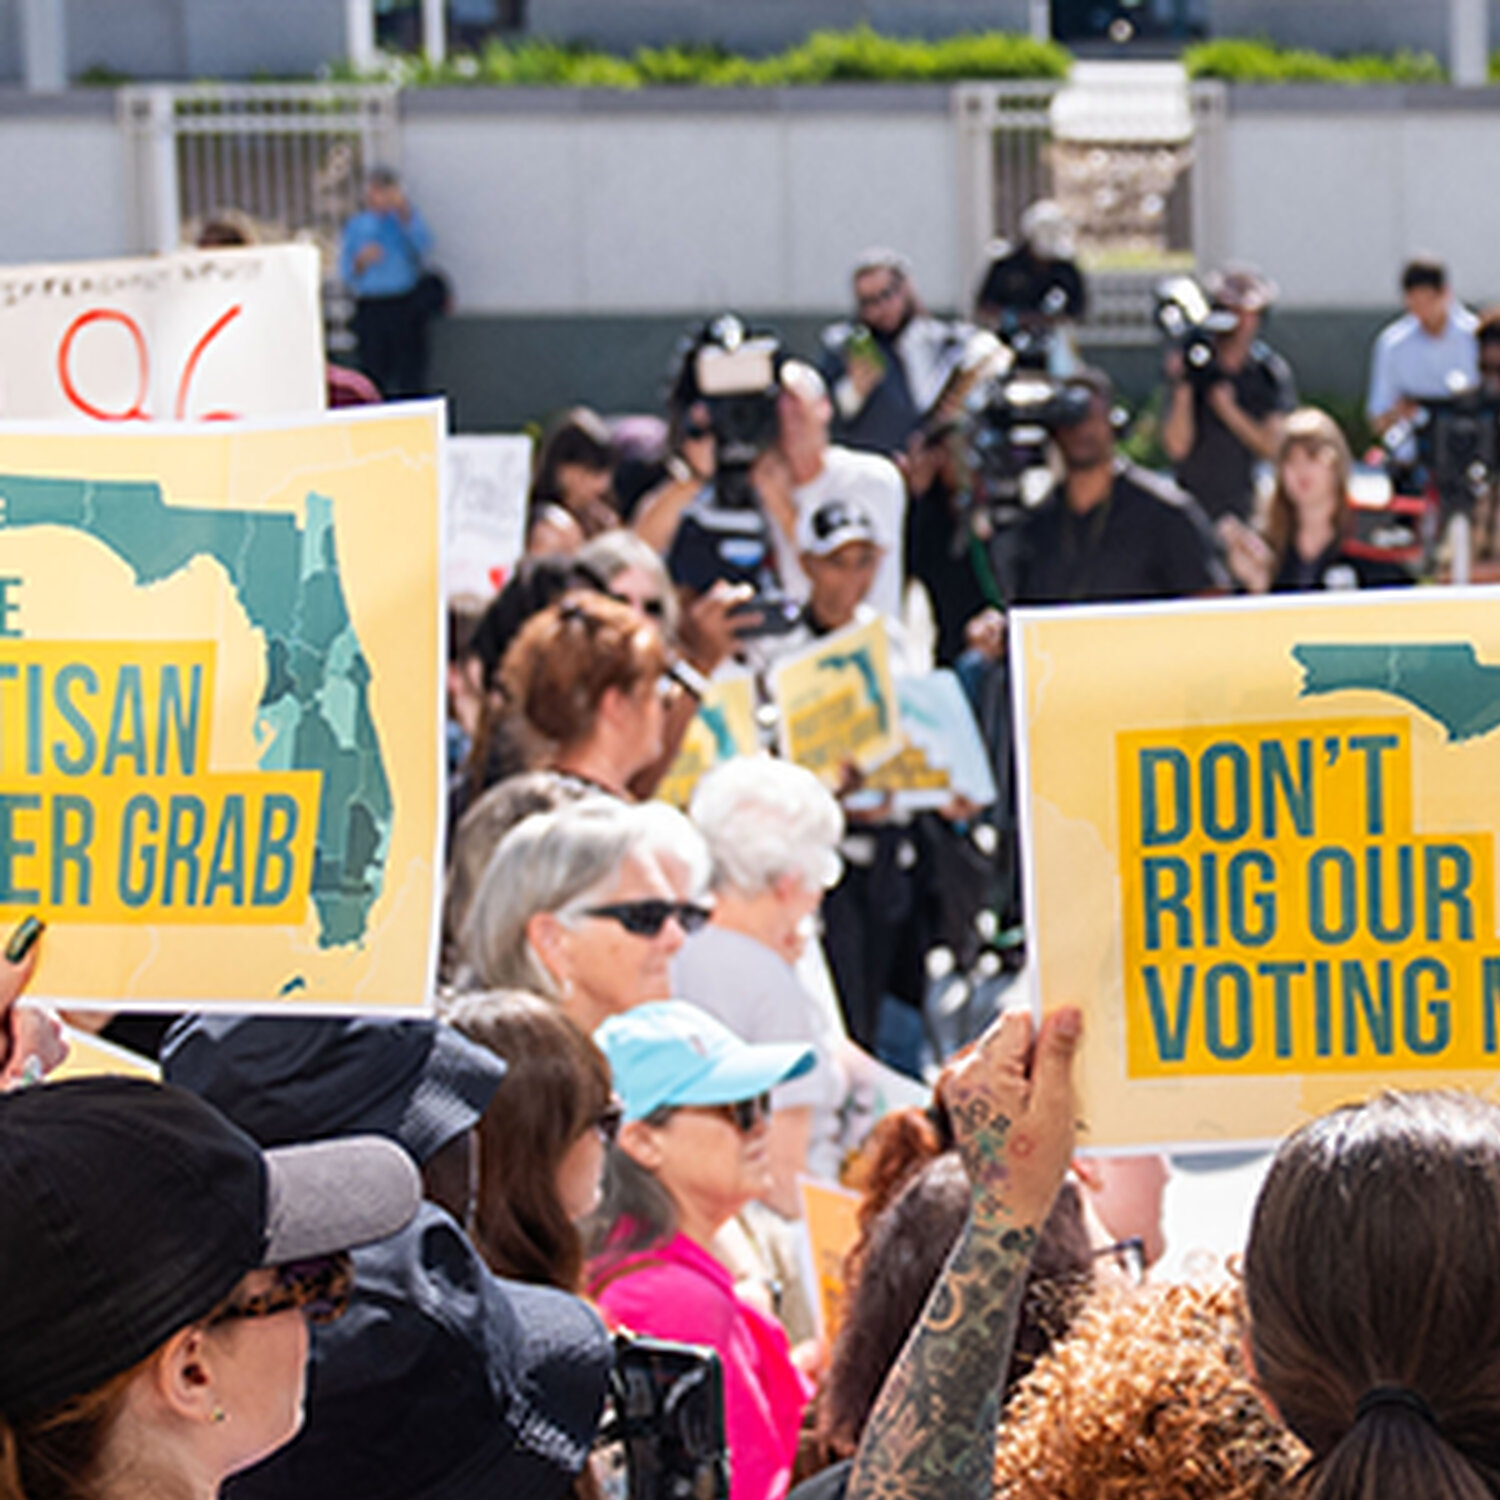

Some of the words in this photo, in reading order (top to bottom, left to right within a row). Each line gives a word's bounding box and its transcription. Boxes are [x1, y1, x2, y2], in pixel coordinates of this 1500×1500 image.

[1138, 735, 1399, 848] DON'T
[118, 792, 299, 908] GRAB
[1141, 851, 1276, 950] RIG
[1307, 844, 1475, 945] OUR
[1141, 957, 1450, 1062] VOTING
